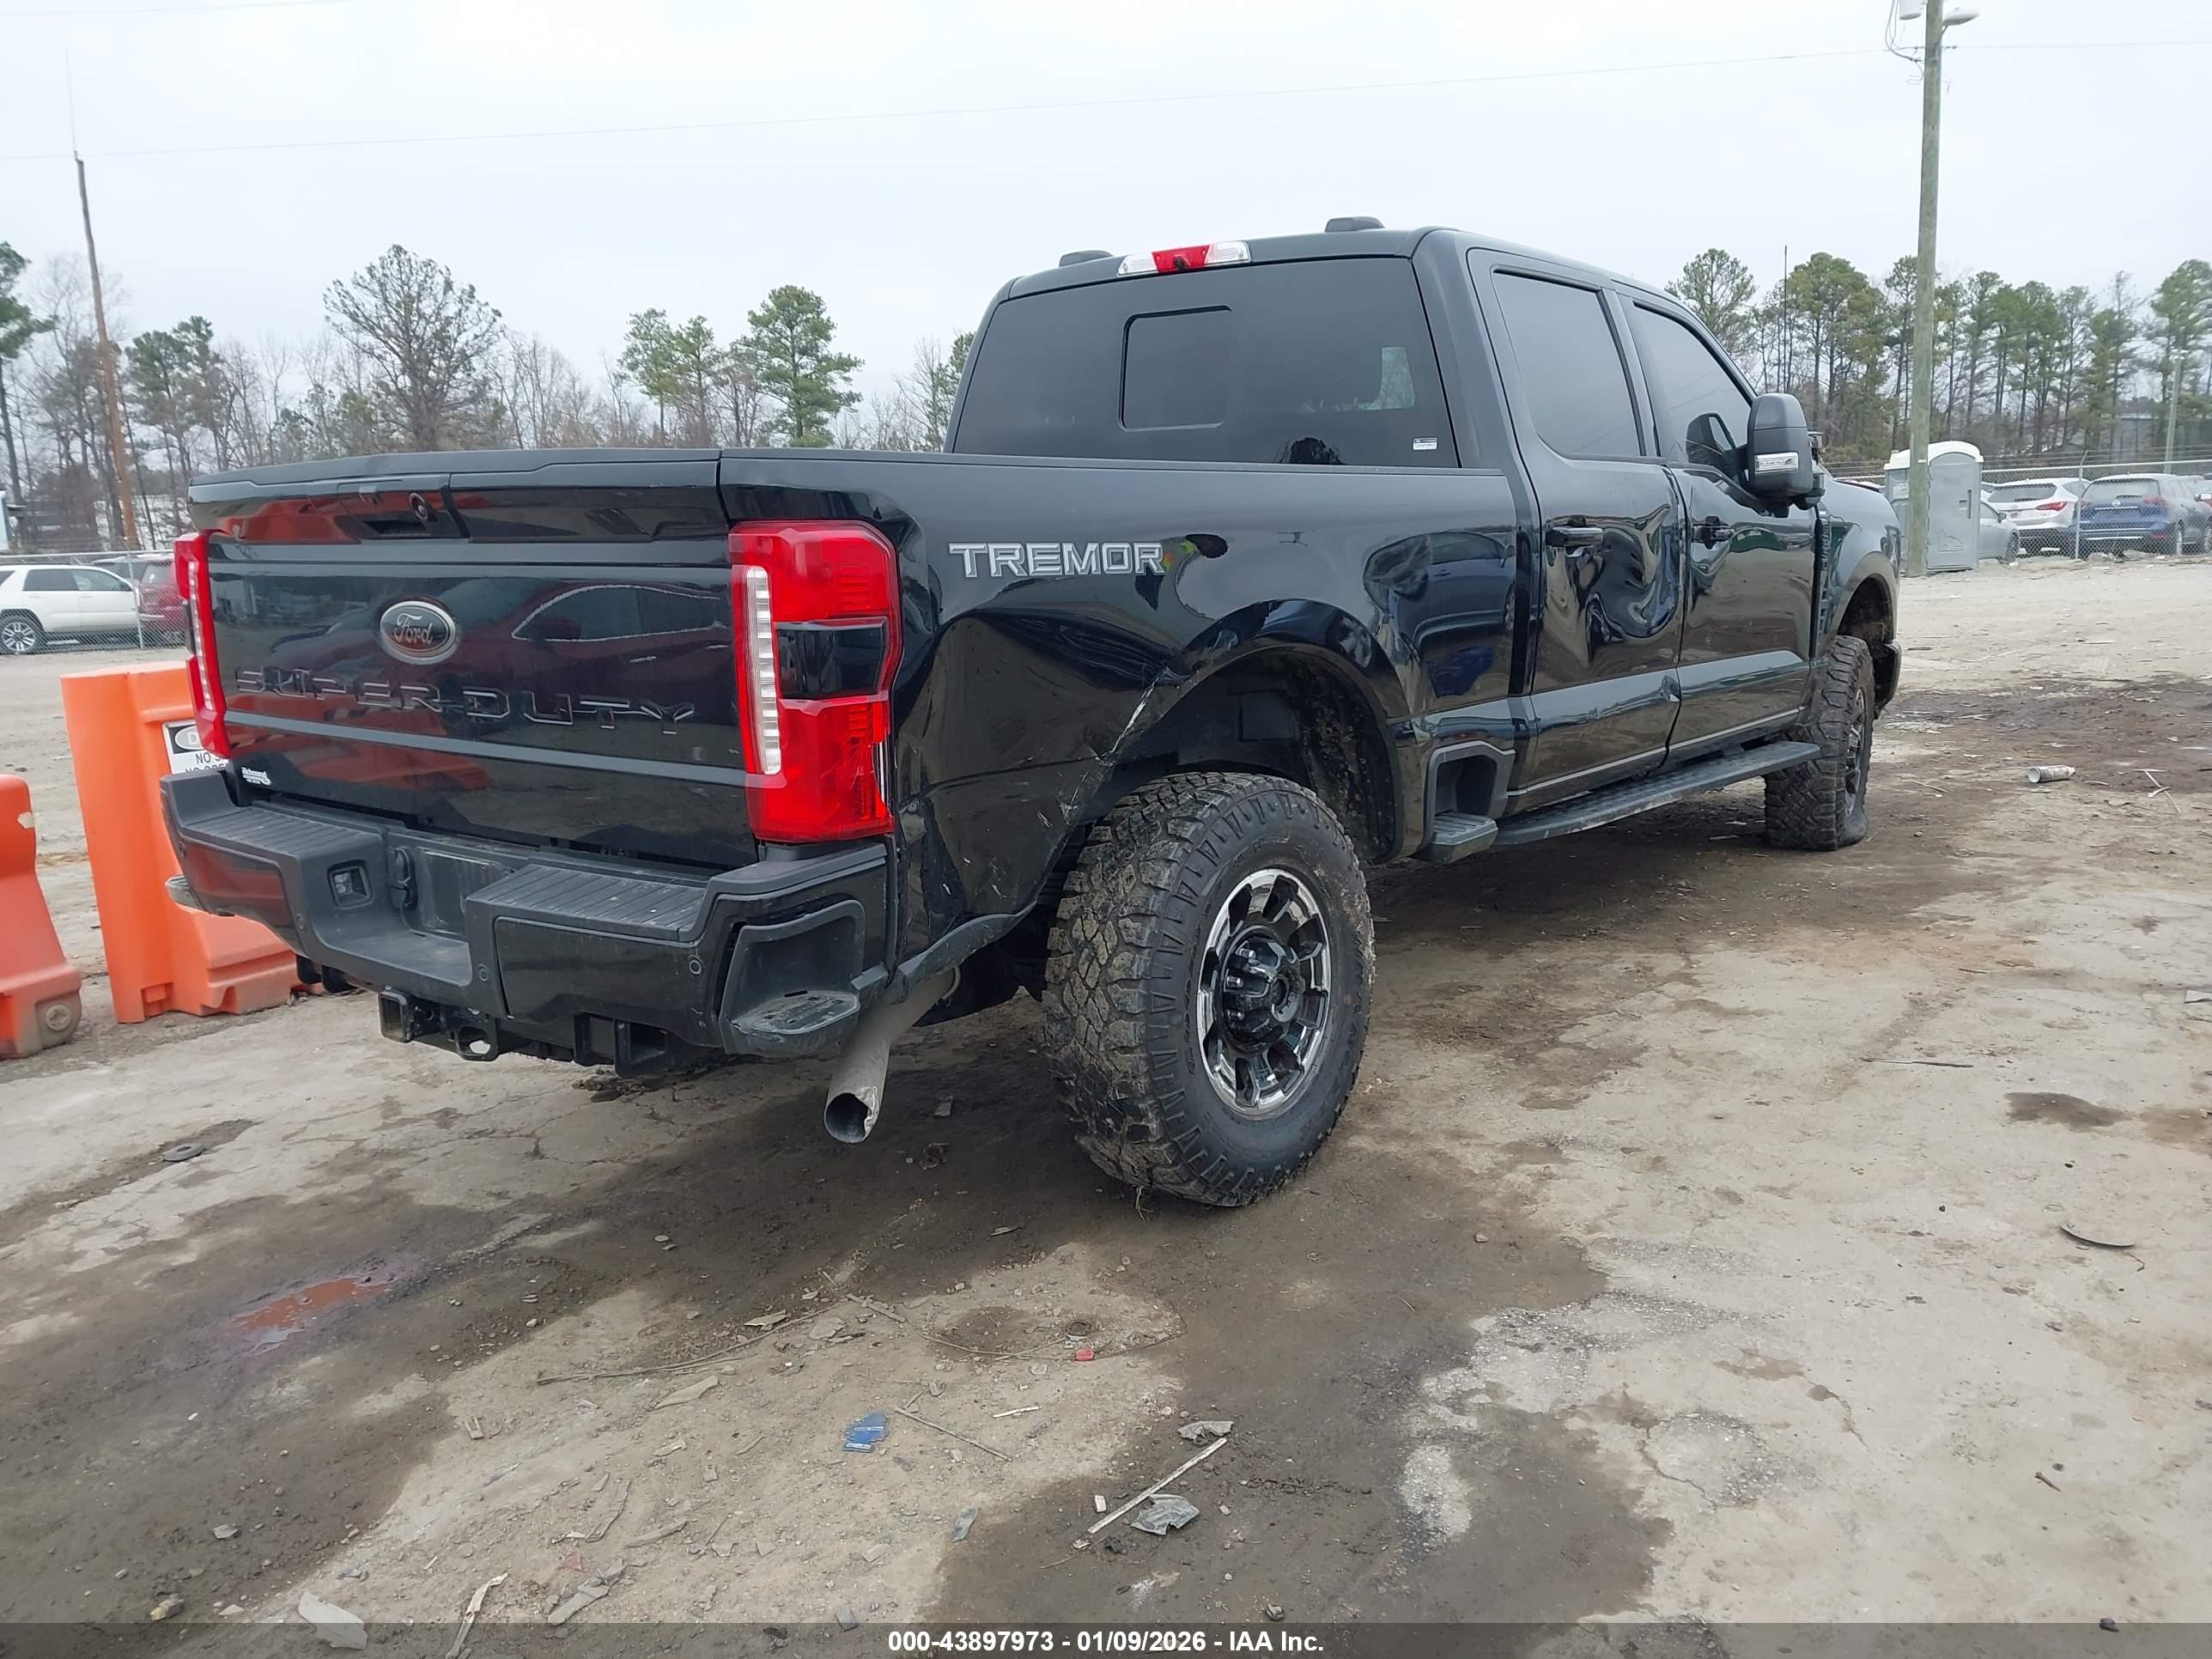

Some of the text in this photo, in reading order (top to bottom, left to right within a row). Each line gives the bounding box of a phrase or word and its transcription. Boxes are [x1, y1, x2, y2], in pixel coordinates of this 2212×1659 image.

[948, 542, 1165, 578] TREMOR
[394, 612, 434, 645] Ford
[234, 665, 695, 735] SUPER DUTY
[195, 752, 211, 764] NO
